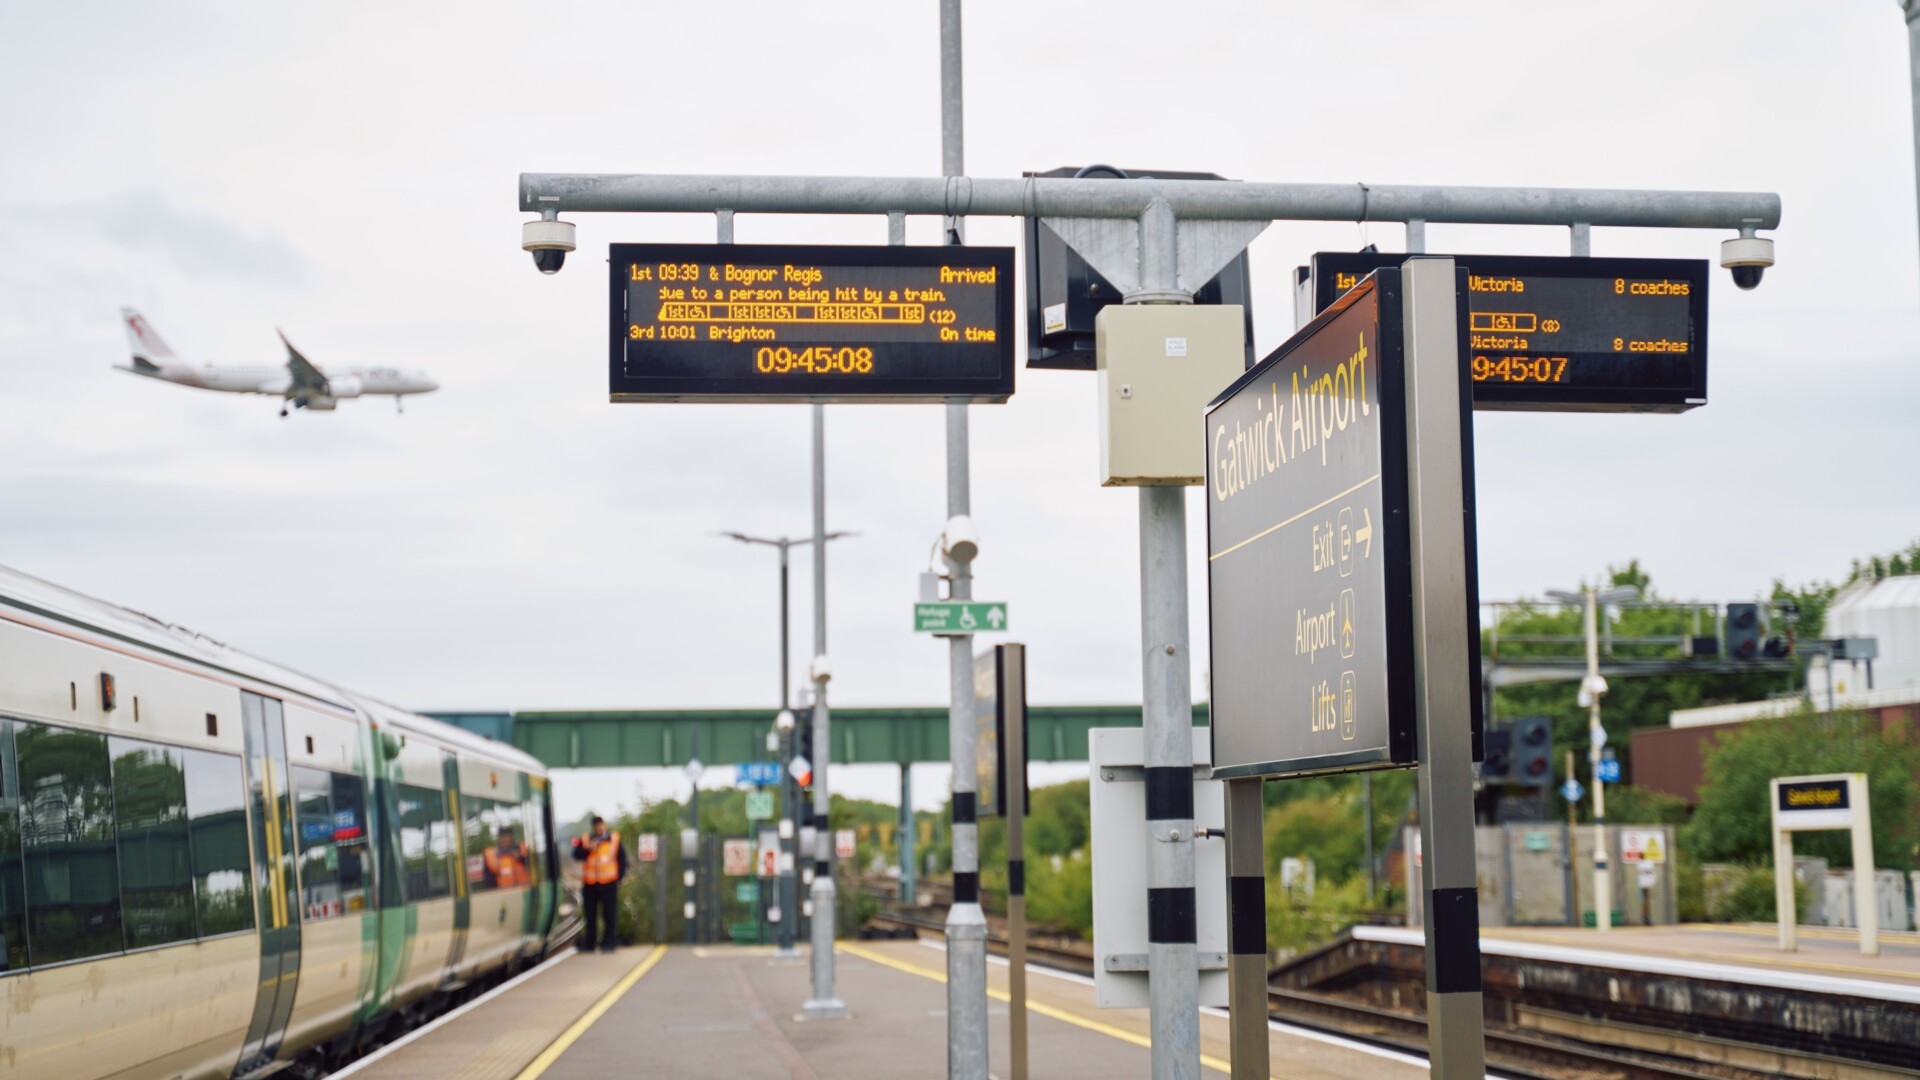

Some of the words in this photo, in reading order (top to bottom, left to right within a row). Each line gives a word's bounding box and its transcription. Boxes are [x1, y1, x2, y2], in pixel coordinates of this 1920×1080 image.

[631, 264, 652, 281] 1st
[659, 264, 699, 281] 09:39
[709, 267, 719, 281] &
[725, 264, 778, 286] Bognor
[784, 265, 823, 286] Regis
[940, 266, 996, 283] Arrived
[1337, 272, 1356, 289] 1st
[1469, 275, 1524, 292] Victoria
[691, 286, 707, 300] to
[714, 289, 724, 300] a
[730, 287, 783, 303] person
[788, 287, 830, 303] being
[835, 288, 858, 301] hit
[864, 288, 882, 303] by
[889, 290, 899, 301] a
[904, 288, 946, 302] train.
[1615, 278, 1625, 295] 8
[1630, 279, 1690, 295] coaches
[667, 304, 684, 319] 1st
[733, 305, 750, 319] 1st
[754, 305, 771, 319] 1st
[819, 306, 835, 320] 1st
[840, 306, 857, 320] 1st
[904, 307, 921, 320] 1st
[929, 310, 956, 324] (12)
[630, 325, 654, 340] 3rd
[660, 325, 696, 340] 10:01
[709, 325, 776, 343] Brighton
[940, 327, 959, 341] On
[965, 327, 996, 342] time
[1541, 319, 1560, 333] (8)
[1614, 338, 1624, 352] 8
[1629, 338, 1688, 353] coaches
[757, 347, 873, 373] 09:45:08
[1472, 356, 1568, 382] 9:45:07
[1214, 382, 1287, 501] Gatwick
[1291, 331, 1370, 466] Airport
[1312, 520, 1335, 573] Exit
[1295, 602, 1336, 664] Airport
[1311, 679, 1336, 733] Lifts
